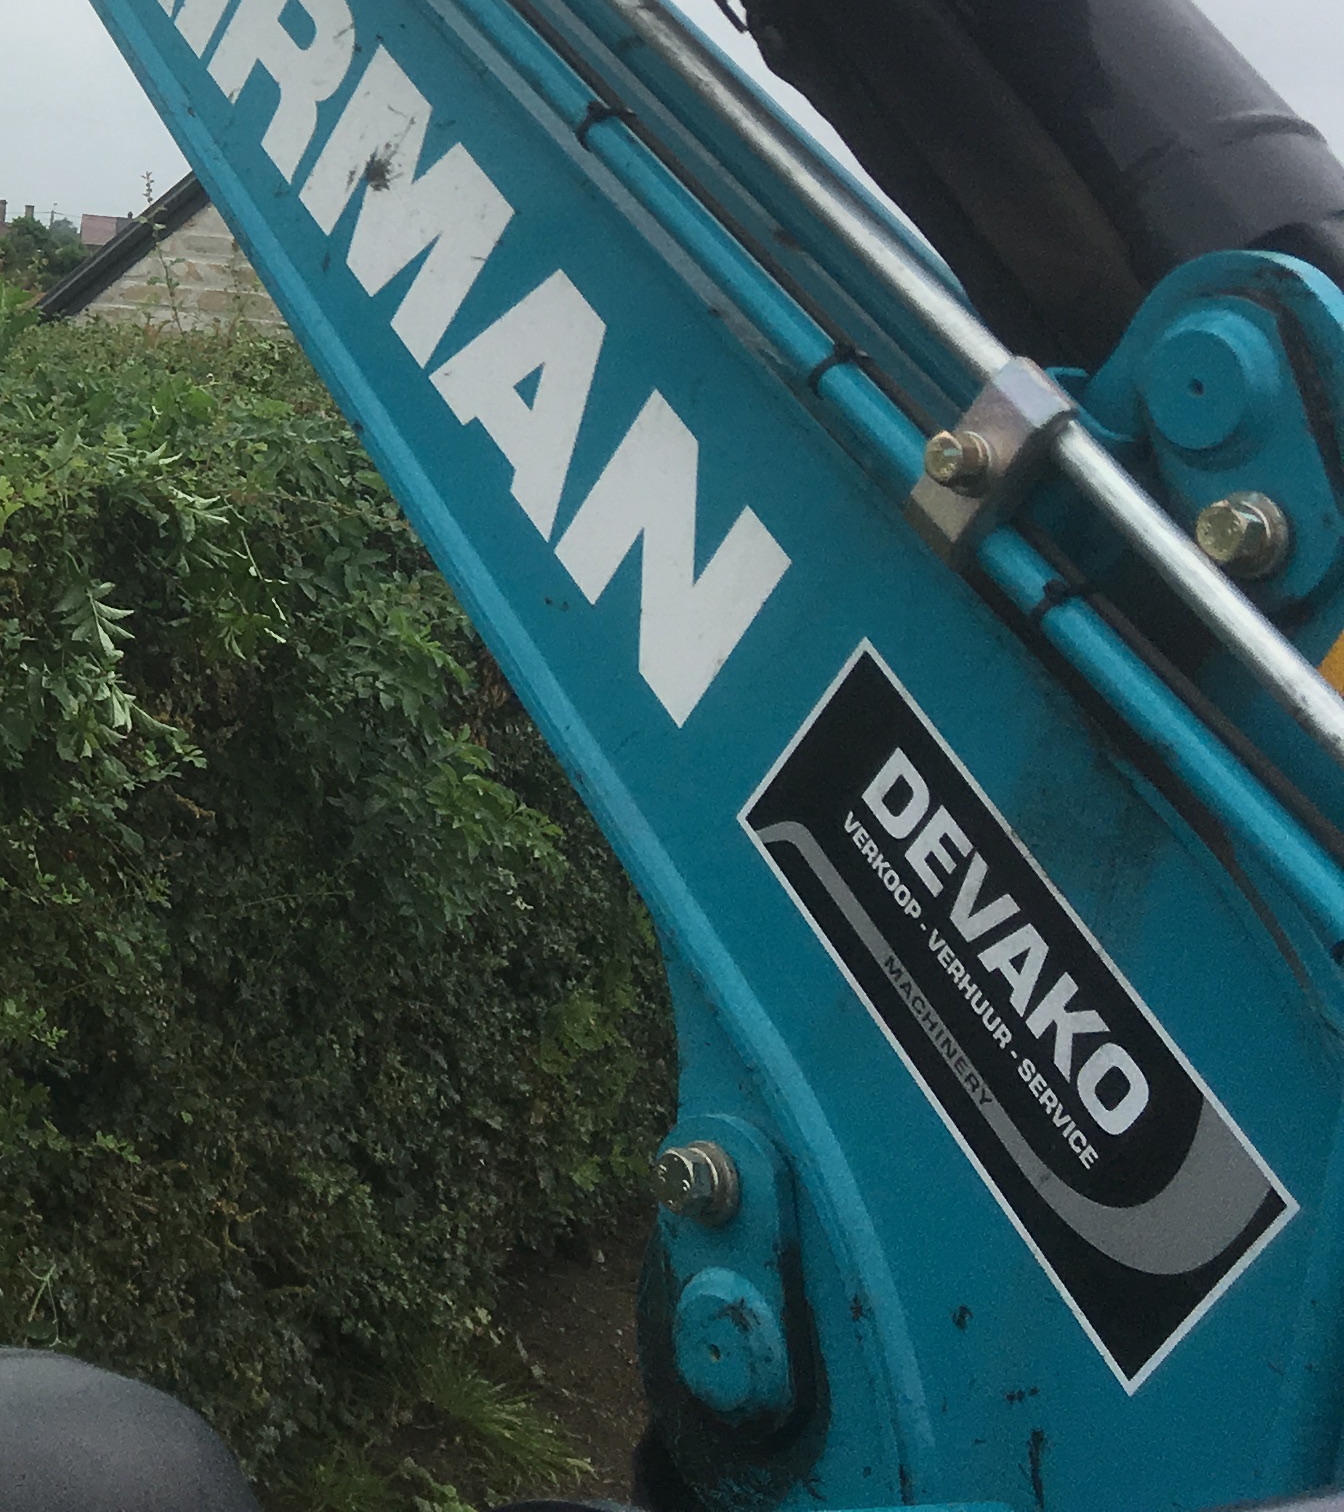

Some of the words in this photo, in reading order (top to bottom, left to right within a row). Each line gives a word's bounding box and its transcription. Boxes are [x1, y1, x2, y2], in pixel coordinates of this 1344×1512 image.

[842, 810, 923, 920] VERKOOP
[926, 928, 1013, 1050] VERHUUR
[1017, 1057, 1099, 1171] SERVICE
[860, 746, 1150, 1136] DEVAKO
[883, 954, 995, 1108] MACHINERY
